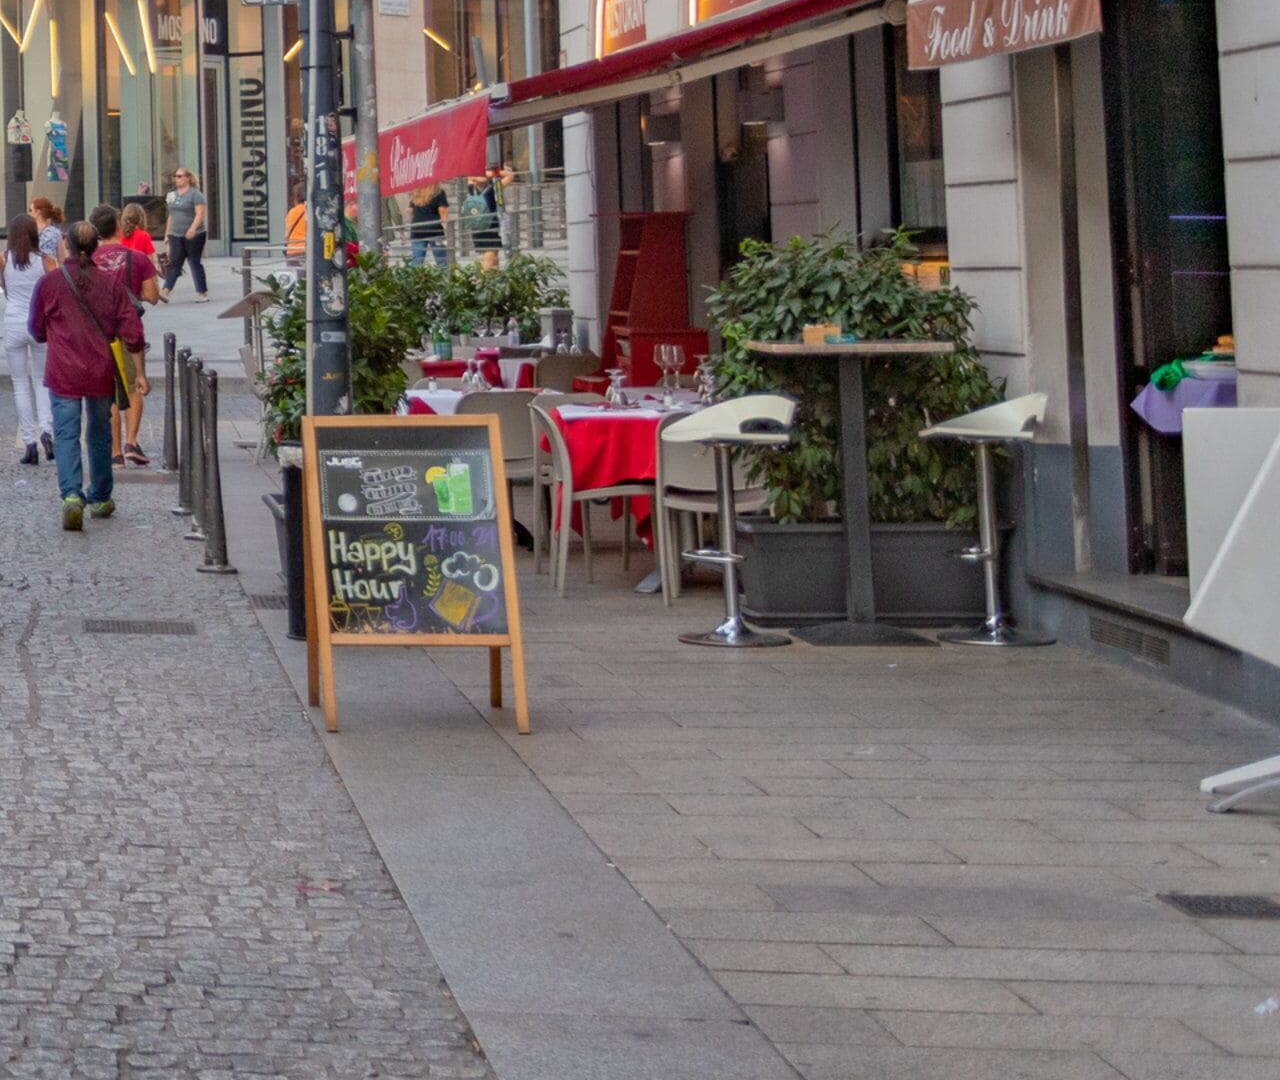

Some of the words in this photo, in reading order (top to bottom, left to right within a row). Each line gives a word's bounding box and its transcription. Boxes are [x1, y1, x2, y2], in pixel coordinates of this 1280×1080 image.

[925, 5, 974, 62] Food
[982, 15, 995, 47] &
[328, 529, 417, 577] Happy
[331, 567, 405, 601] Hour
